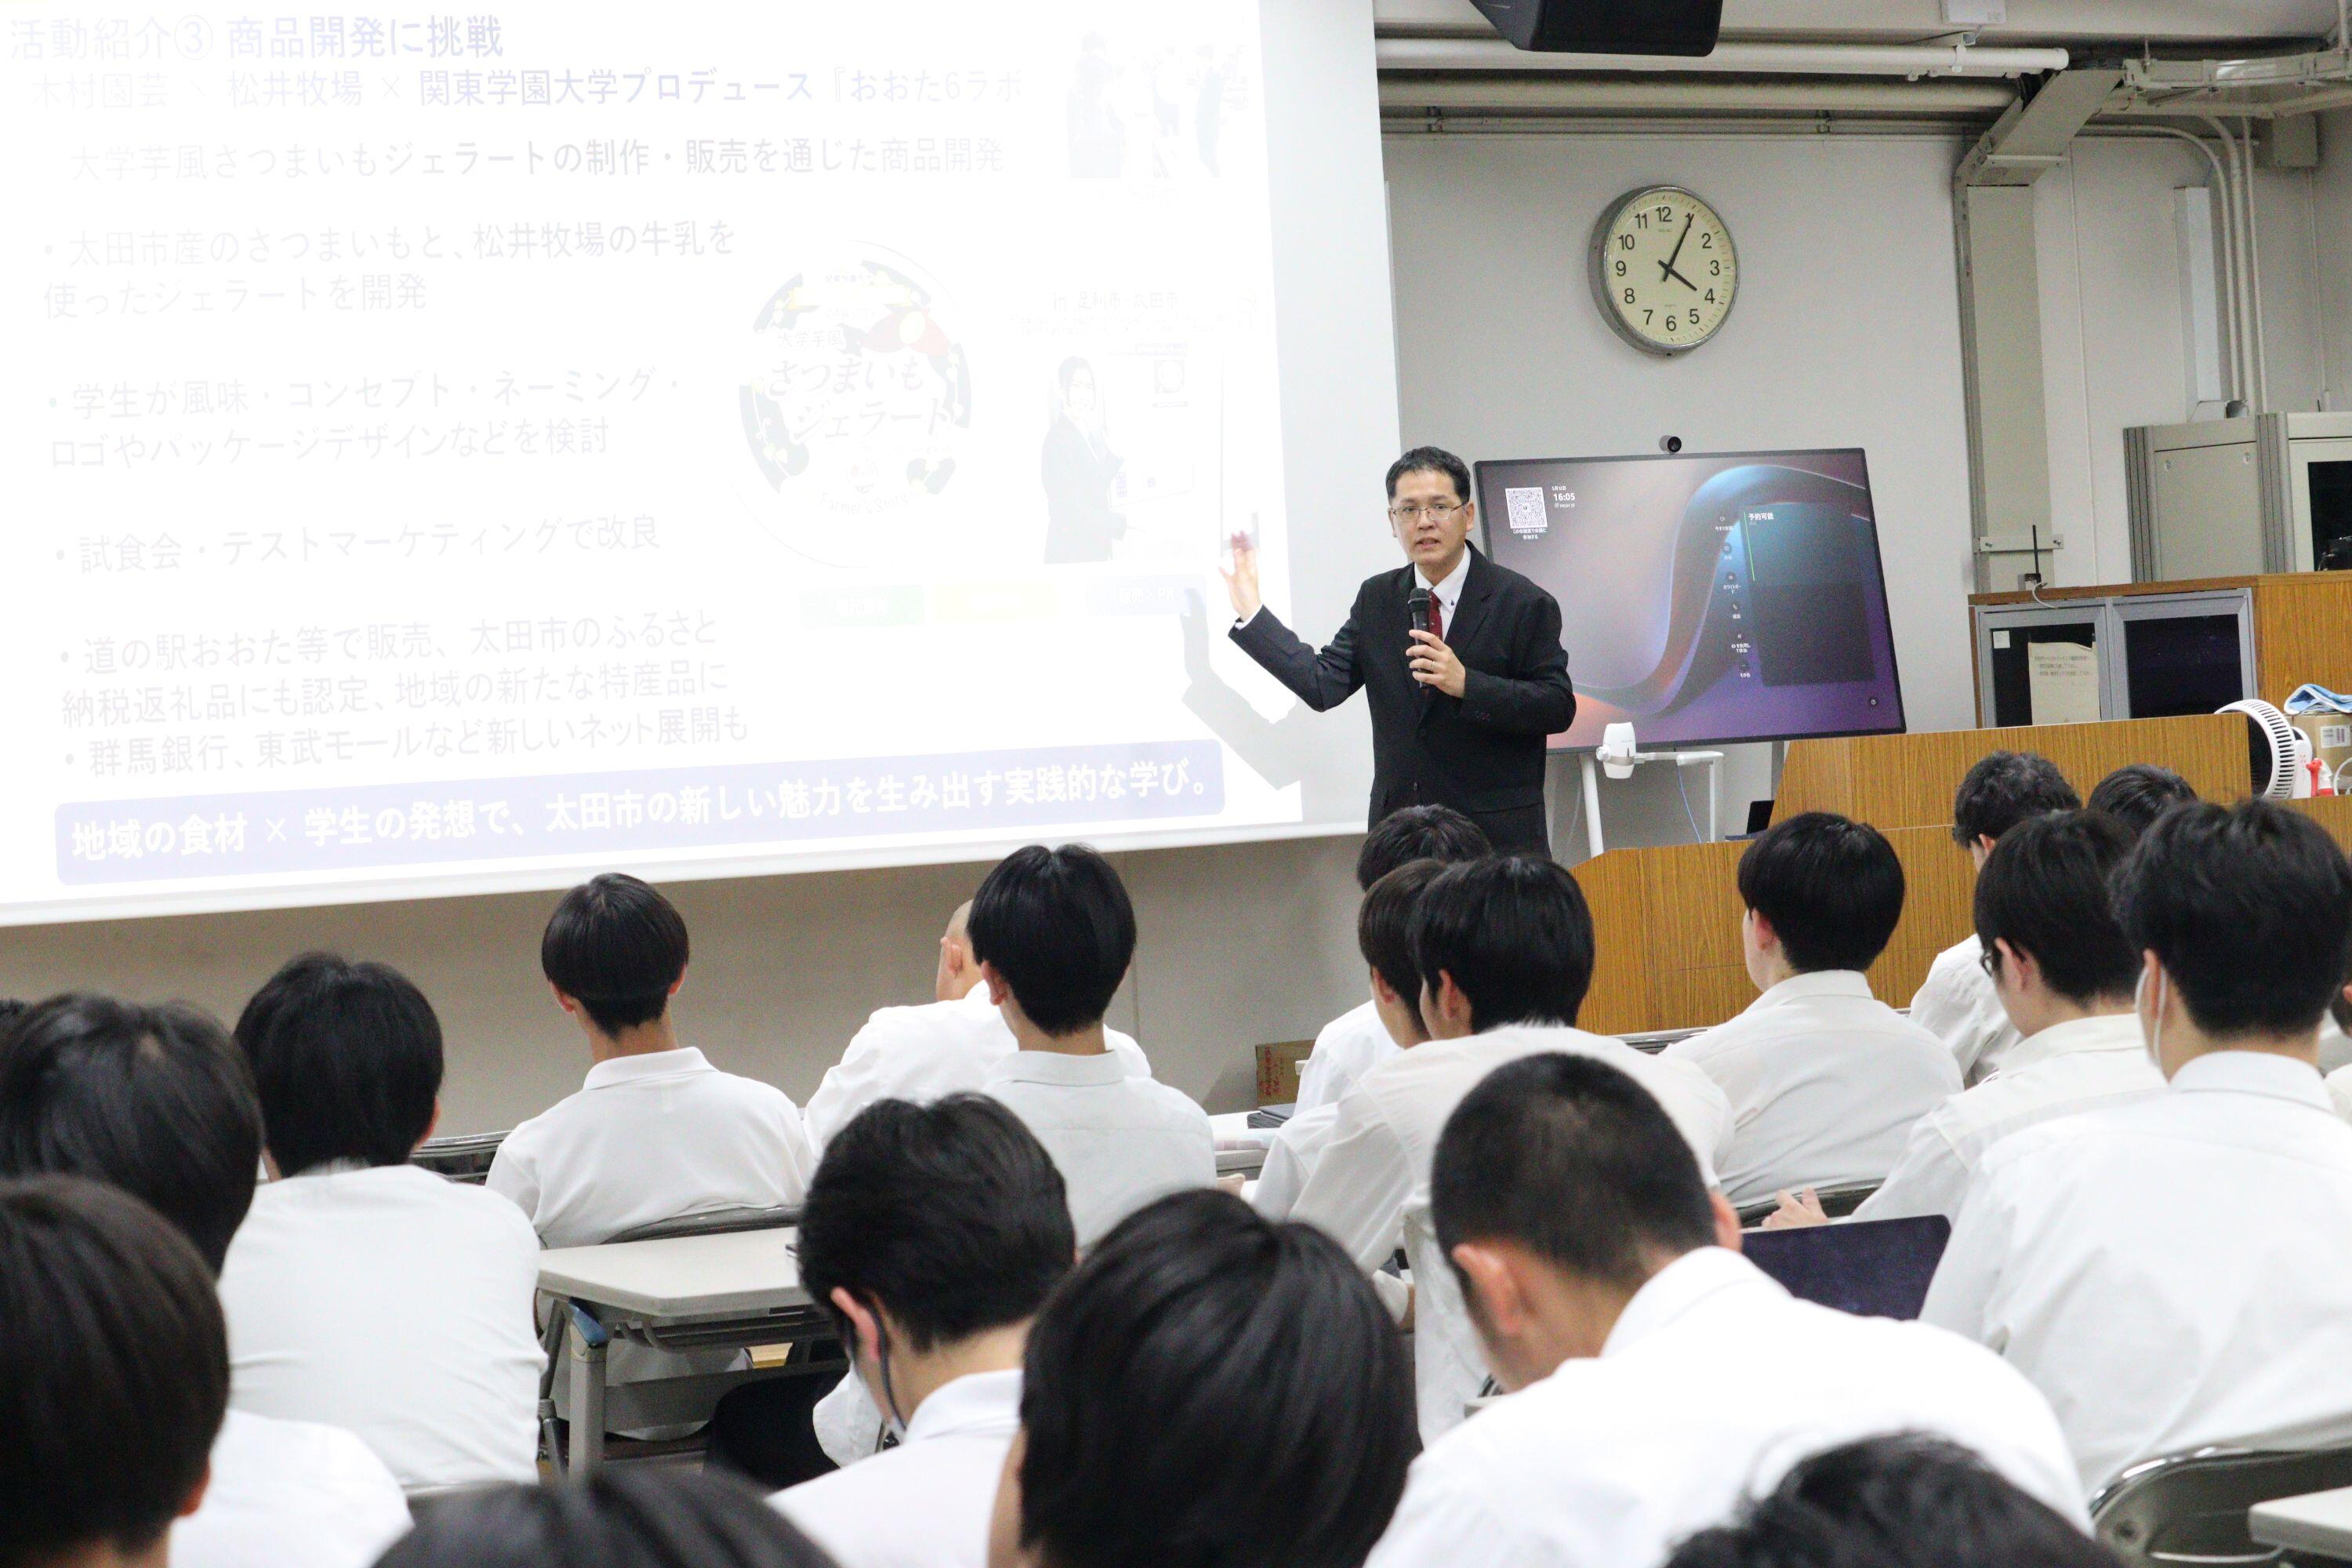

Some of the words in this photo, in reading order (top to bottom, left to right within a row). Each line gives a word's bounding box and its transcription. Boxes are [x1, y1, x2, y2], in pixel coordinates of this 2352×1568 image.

[10, 15, 213, 60] 活動紹介③
[227, 14, 503, 59] 商品開発に挑戦
[31, 71, 169, 110] 木村園芸
[227, 71, 364, 107] 松井牧場
[1635, 213, 1648, 230] 11
[1656, 206, 1672, 223] 12
[1618, 234, 1635, 250] 10
[1702, 233, 1711, 249] 2
[1616, 260, 1626, 277] 9
[1710, 260, 1720, 276] 3
[44, 273, 426, 320] 使ったジェラートを開発
[1624, 288, 1635, 304] 8
[1704, 289, 1715, 304] 4
[1643, 310, 1653, 325] 7
[1666, 315, 1676, 332] 6
[1690, 309, 1700, 325] 5
[769, 357, 923, 397] さつまいも
[793, 397, 948, 440] ジェラート
[52, 416, 609, 469] ロゴやパッケージデザインなどを検討
[1553, 492, 1576, 502] 16:05
[1748, 512, 1774, 521] 予約可能
[79, 513, 661, 574] 試食会・テストマーケティングで改良
[62, 659, 728, 729] 納税返礼品にも認定、地域の新たな特産品に
[89, 706, 747, 778] 群馬銀行、東武モールなど新しいネット展開も
[71, 811, 247, 862] 地域の食材
